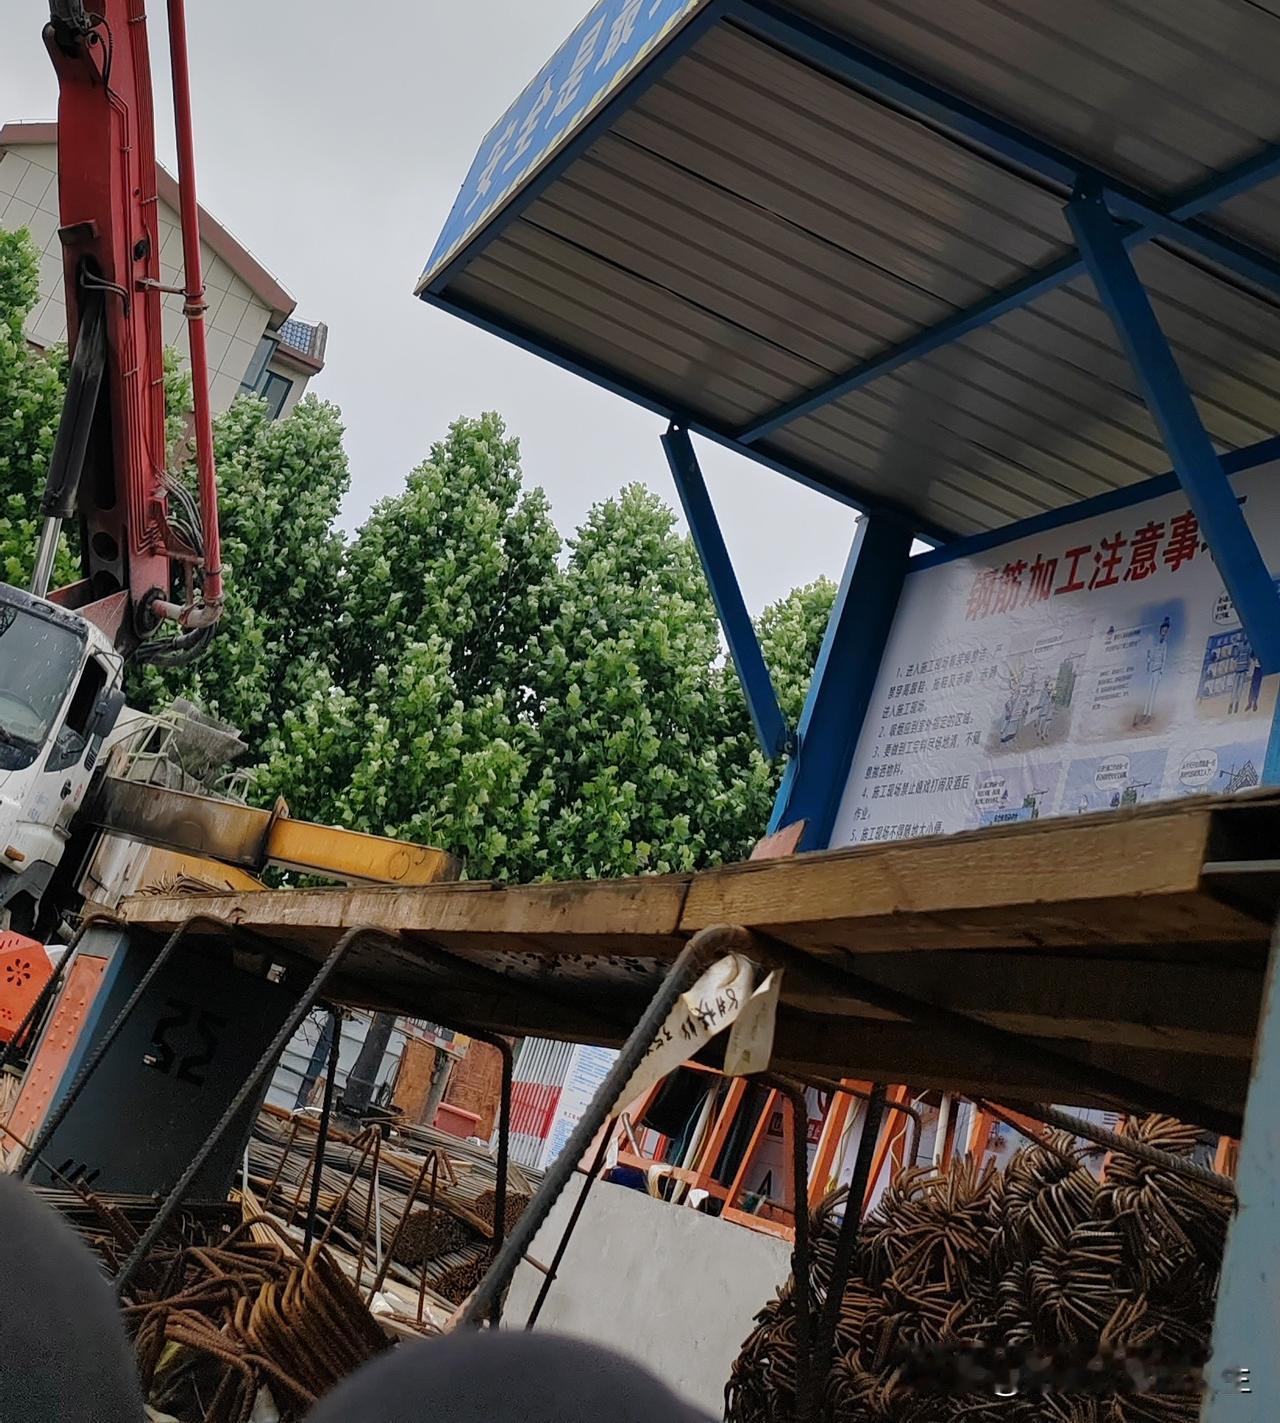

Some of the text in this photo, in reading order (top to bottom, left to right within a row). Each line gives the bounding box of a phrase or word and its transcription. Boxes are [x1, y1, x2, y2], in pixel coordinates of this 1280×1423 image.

[964, 495, 1247, 623] 钢筋加工注意事
